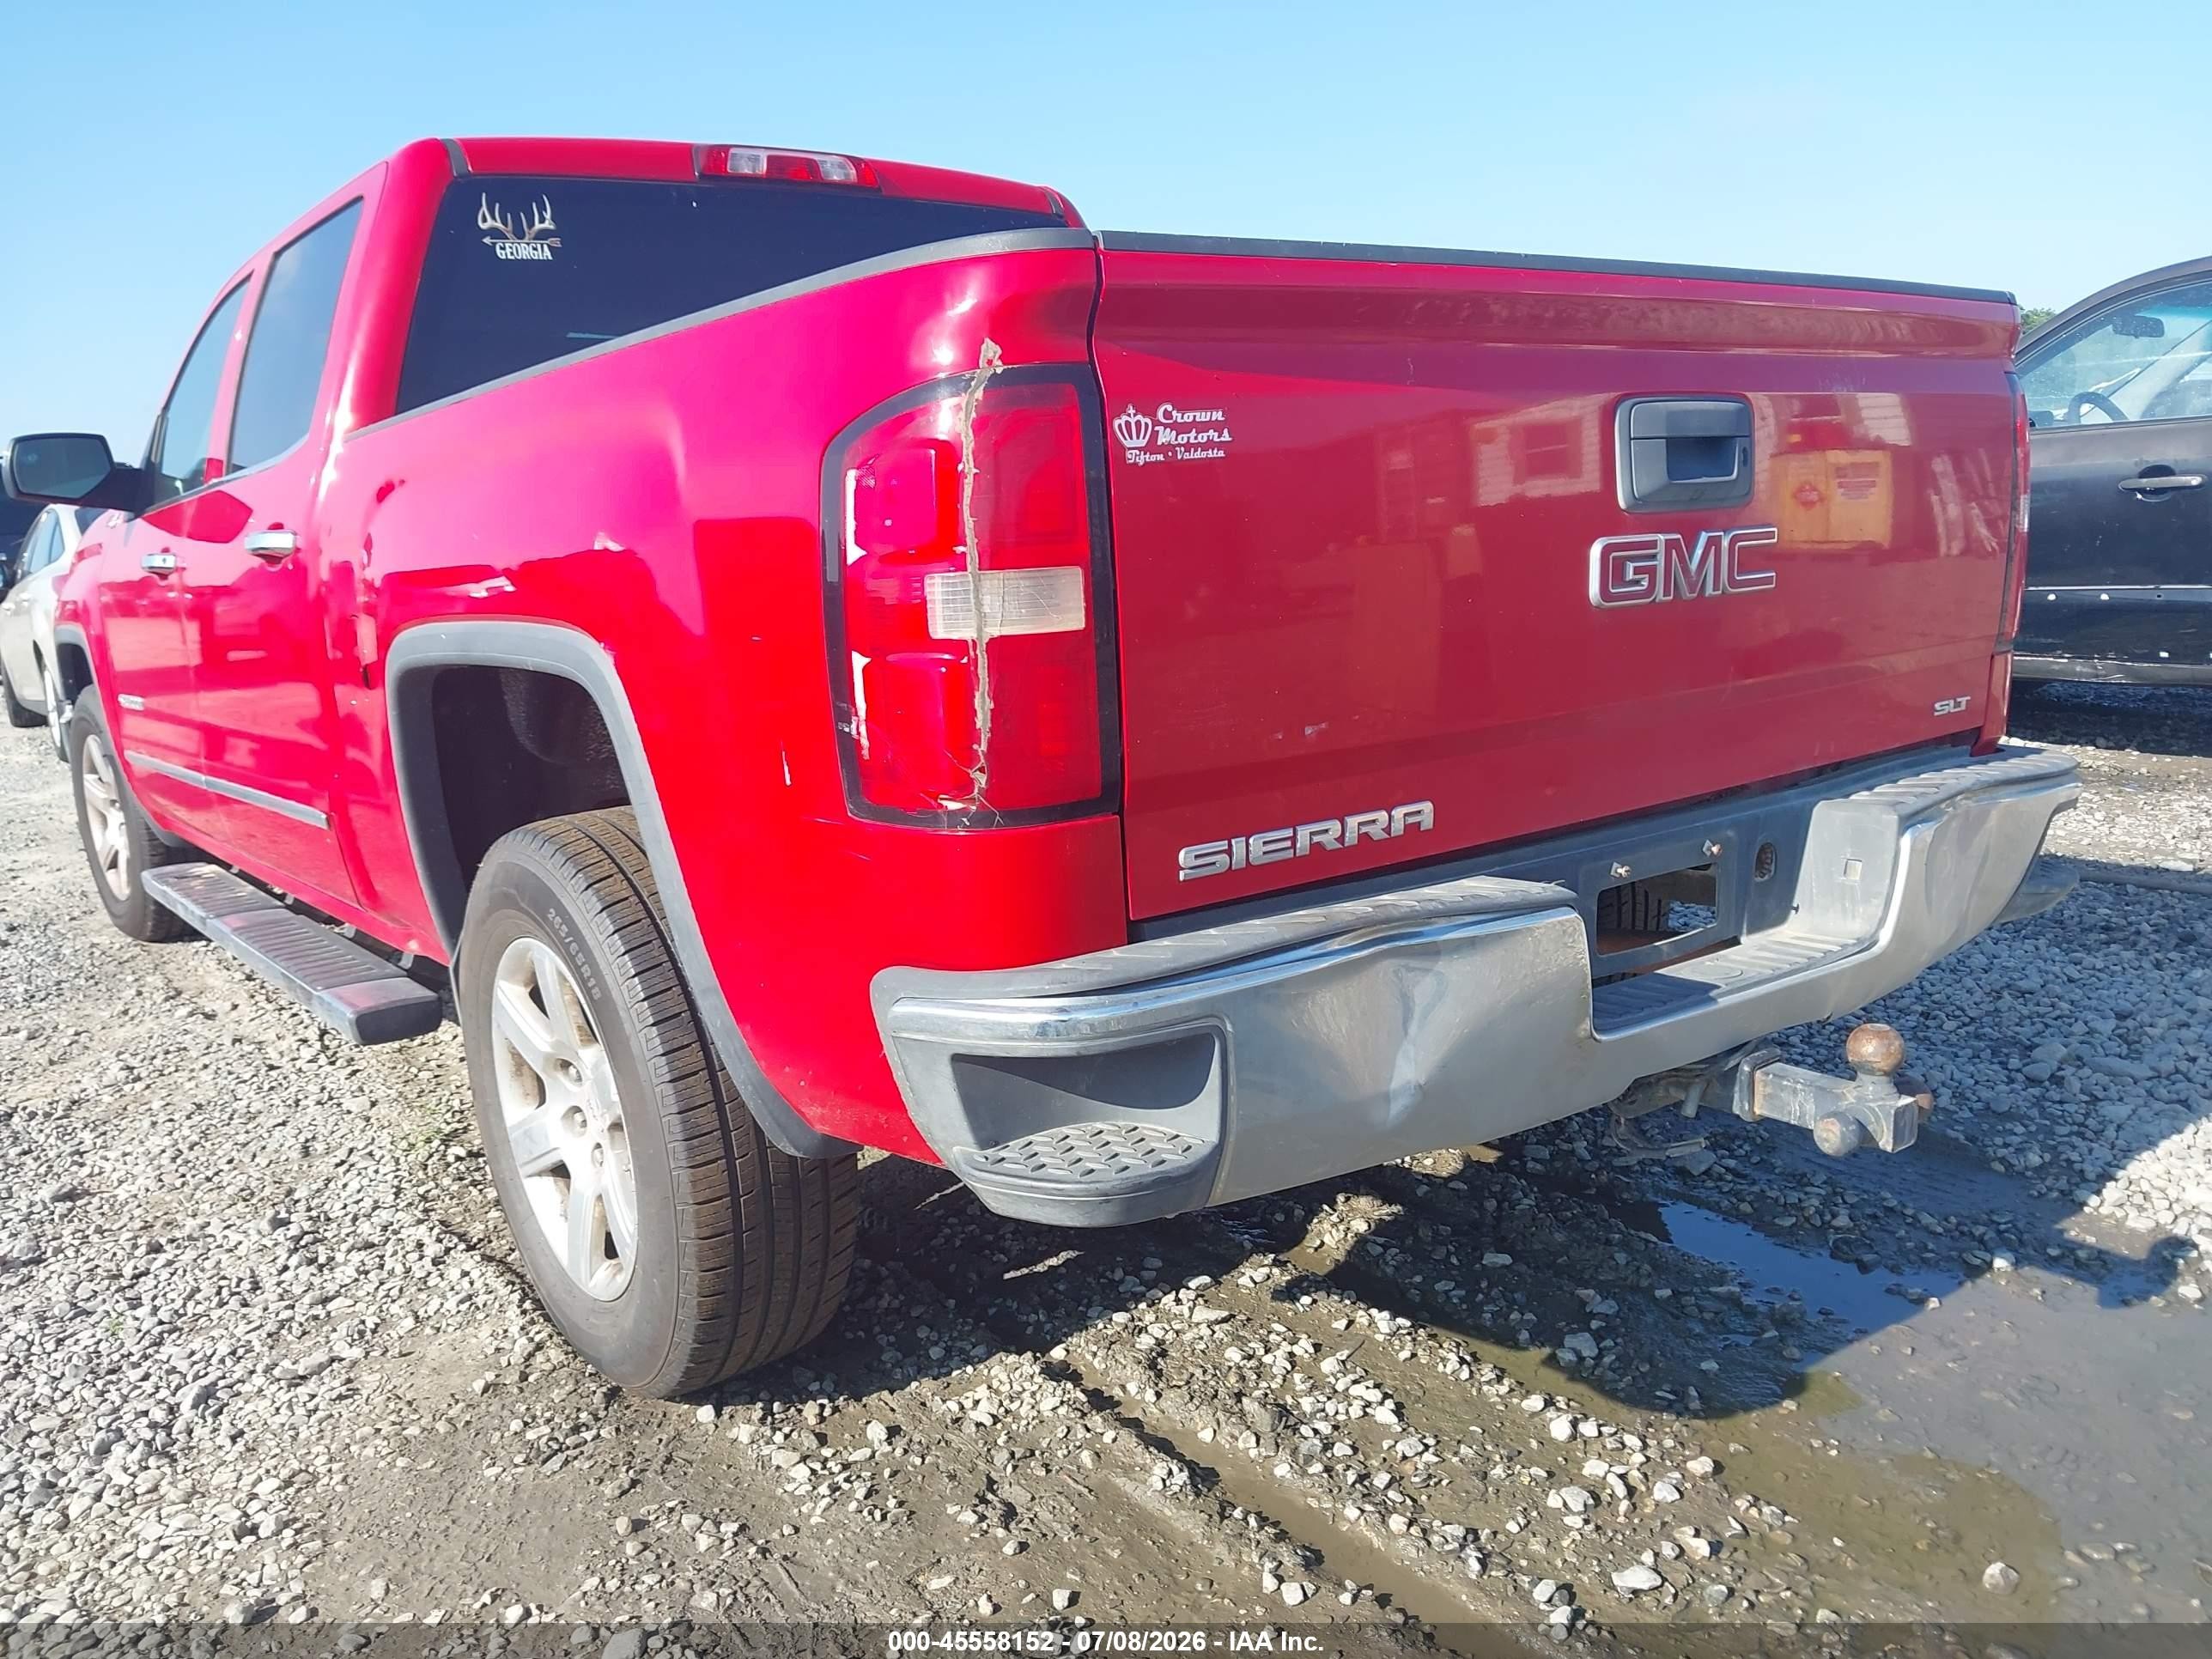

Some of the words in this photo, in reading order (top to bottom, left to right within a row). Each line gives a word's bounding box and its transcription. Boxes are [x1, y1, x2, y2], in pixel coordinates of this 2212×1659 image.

[495, 243, 554, 260] GEORGIA
[1158, 404, 1225, 423] Crown
[1154, 426, 1232, 445] Motors
[1127, 449, 1165, 466] Tifton
[1176, 447, 1225, 459] Valdosta
[1589, 525, 1778, 609] GMC
[1934, 696, 1971, 716] SLT
[1178, 800, 1434, 881] SIERRA
[547, 908, 602, 1000] 265/65R18
